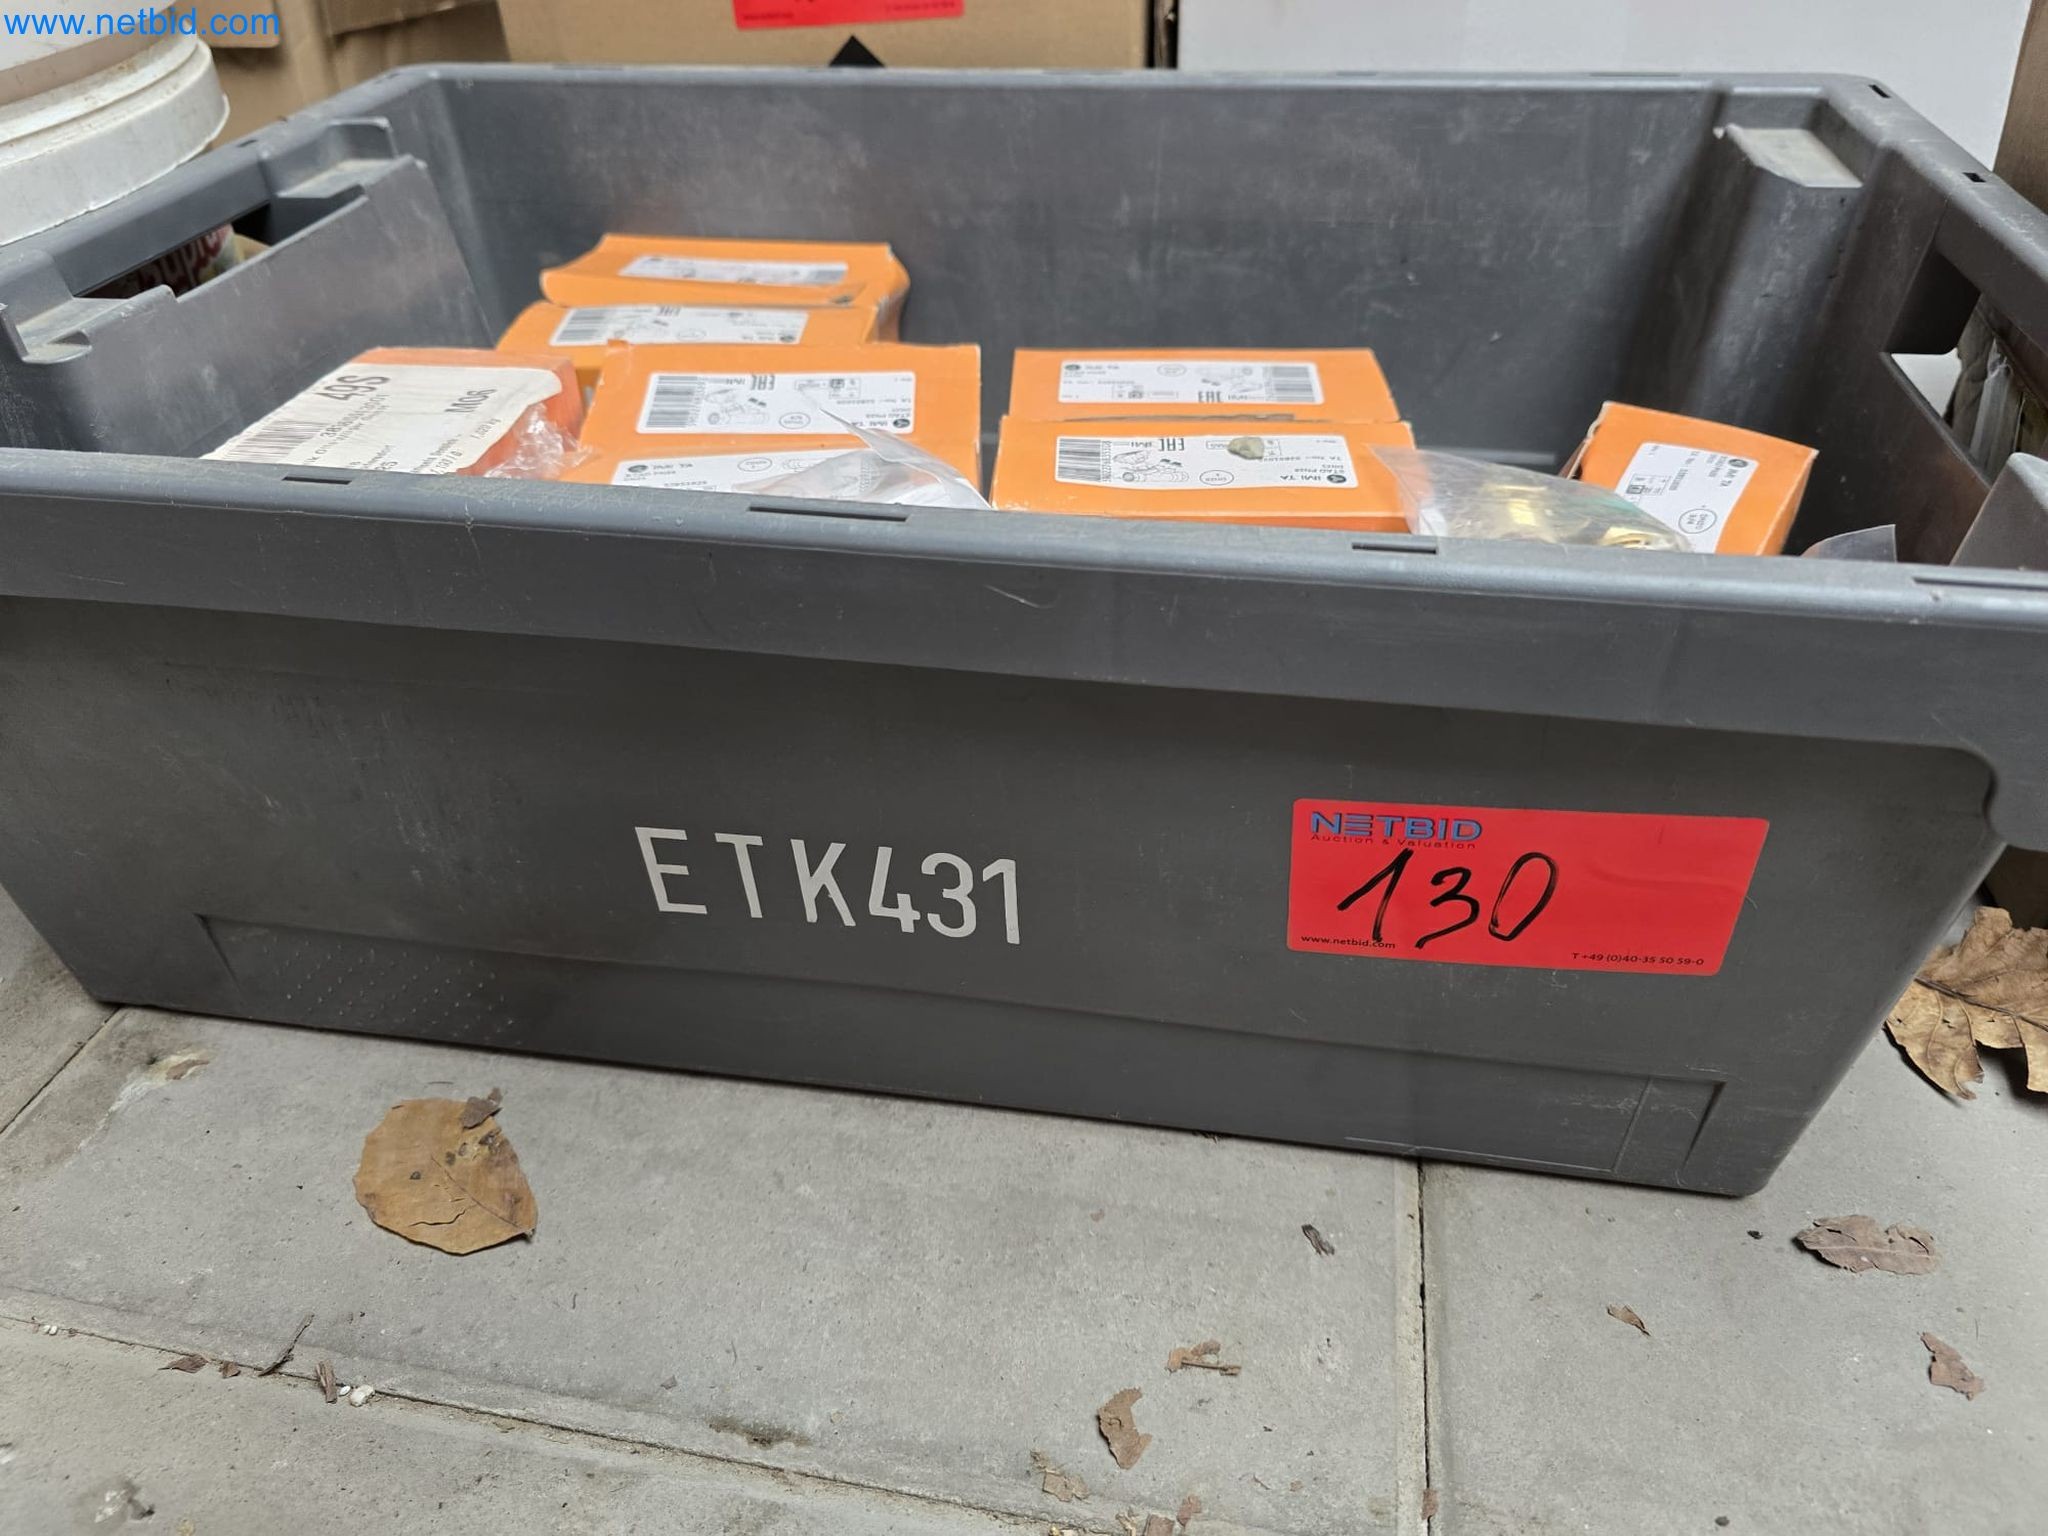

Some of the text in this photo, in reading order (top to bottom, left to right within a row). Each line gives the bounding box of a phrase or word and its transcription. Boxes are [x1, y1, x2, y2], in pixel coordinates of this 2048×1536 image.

[1311, 811, 1482, 843] NETBID
[1310, 834, 1373, 844] Auction
[1397, 839, 1476, 849] Valuation
[1336, 847, 1559, 949] 130
[1301, 936, 1396, 949] www.netbid.com
[1572, 952, 1580, 960] T
[1581, 953, 1604, 961] +49
[1606, 953, 1656, 964] (0)40-35
[1677, 957, 1705, 966] 59-0
